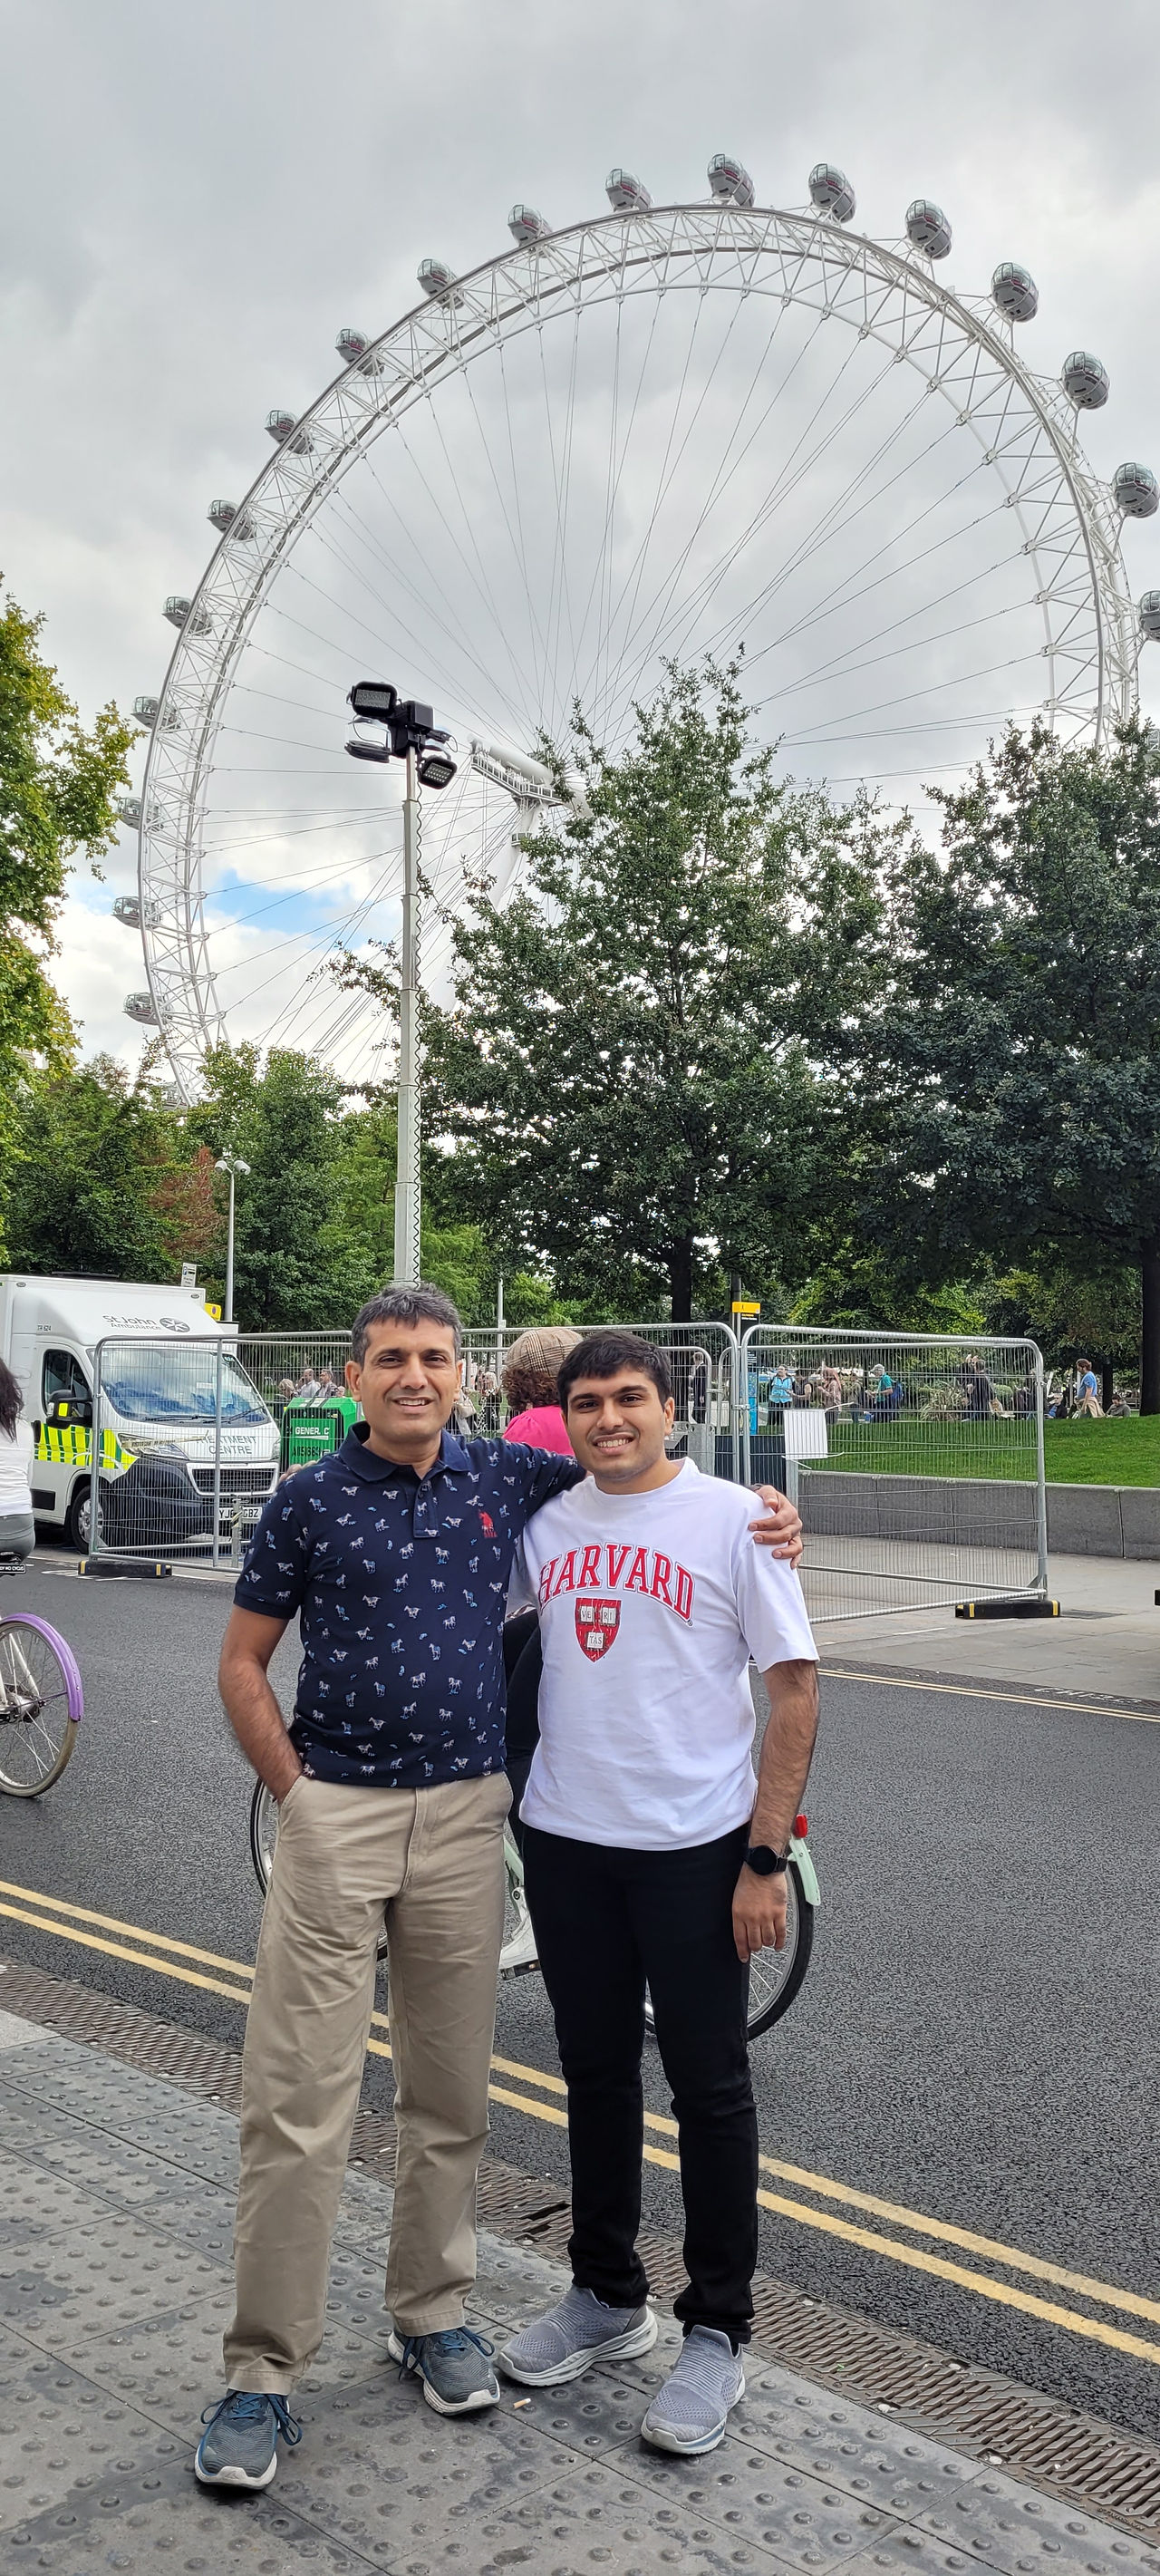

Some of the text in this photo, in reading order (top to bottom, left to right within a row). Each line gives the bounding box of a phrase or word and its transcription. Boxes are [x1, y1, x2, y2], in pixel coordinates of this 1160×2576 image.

[102, 1315, 156, 1325] St John
[538, 1543, 695, 1622] HARVARD
[582, 1610, 592, 1619] VE
[590, 1635, 603, 1645] TAS
